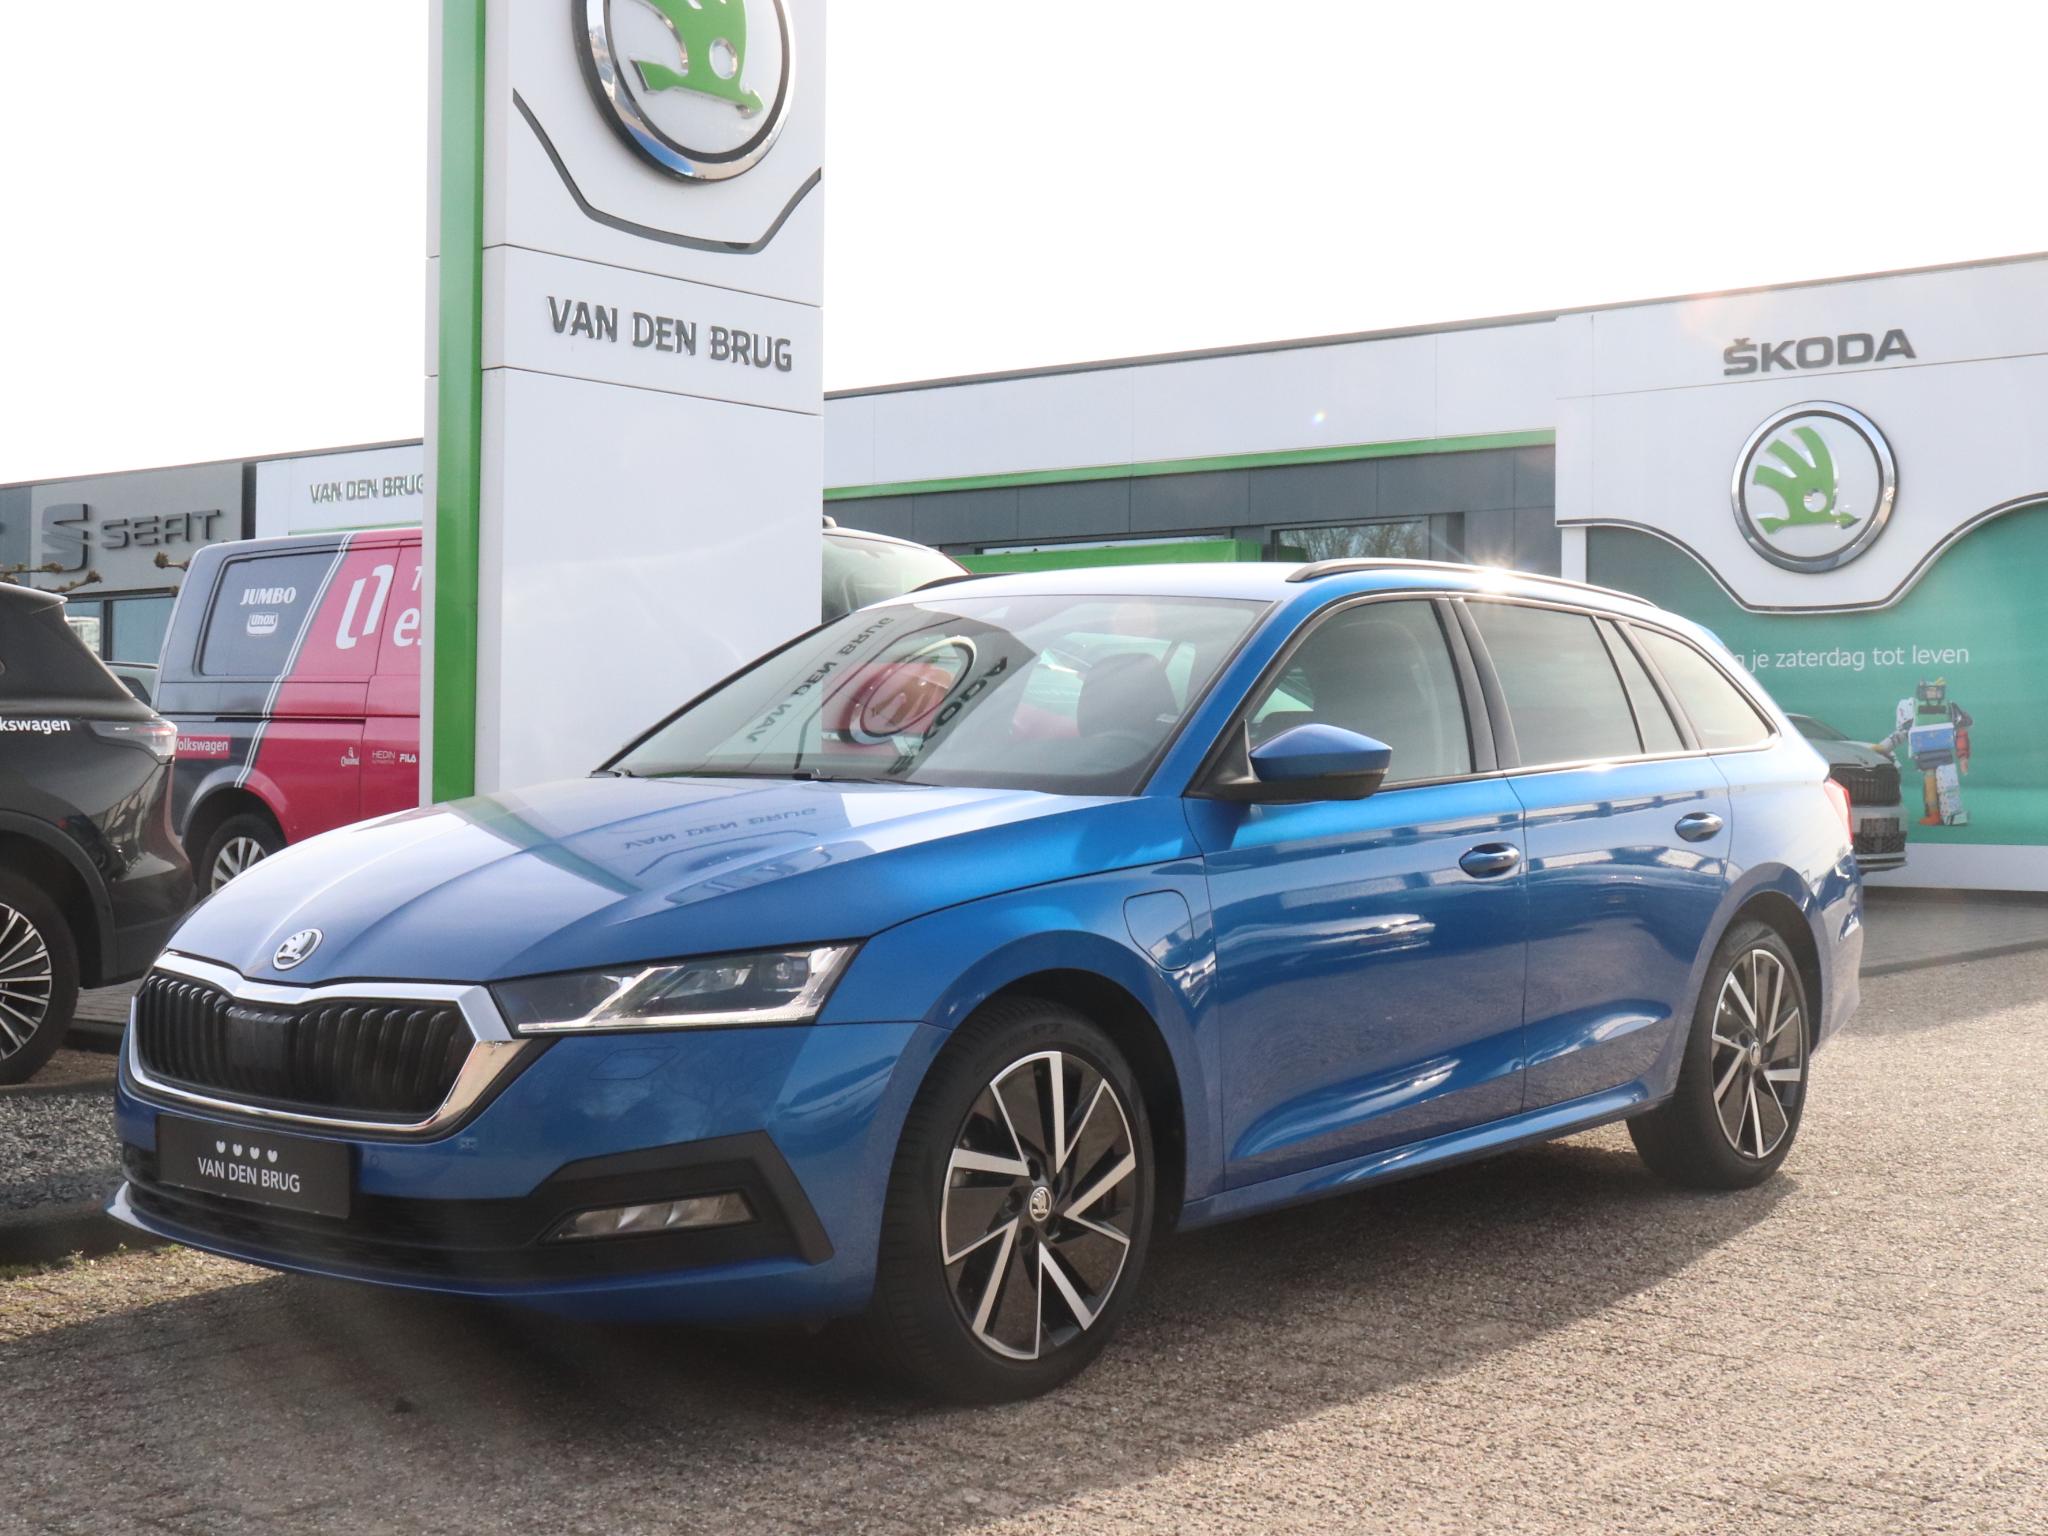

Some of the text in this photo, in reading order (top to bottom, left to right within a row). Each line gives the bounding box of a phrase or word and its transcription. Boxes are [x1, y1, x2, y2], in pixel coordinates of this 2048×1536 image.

[547, 296, 793, 372] VAN DEN BRUG
[1723, 328, 1917, 376] ŠKODA
[310, 481, 342, 504] VAN
[346, 478, 378, 501] DEN
[102, 509, 221, 550] SEAT
[240, 586, 297, 605] JUMBO
[1750, 649, 1769, 673] je
[1775, 647, 1865, 671] zaterdag
[1872, 646, 1904, 666] tot
[1912, 644, 1969, 664] leven
[0, 716, 71, 735] kswagen
[399, 753, 417, 763] FILA
[198, 1157, 300, 1193] VAN DEN BRUG
